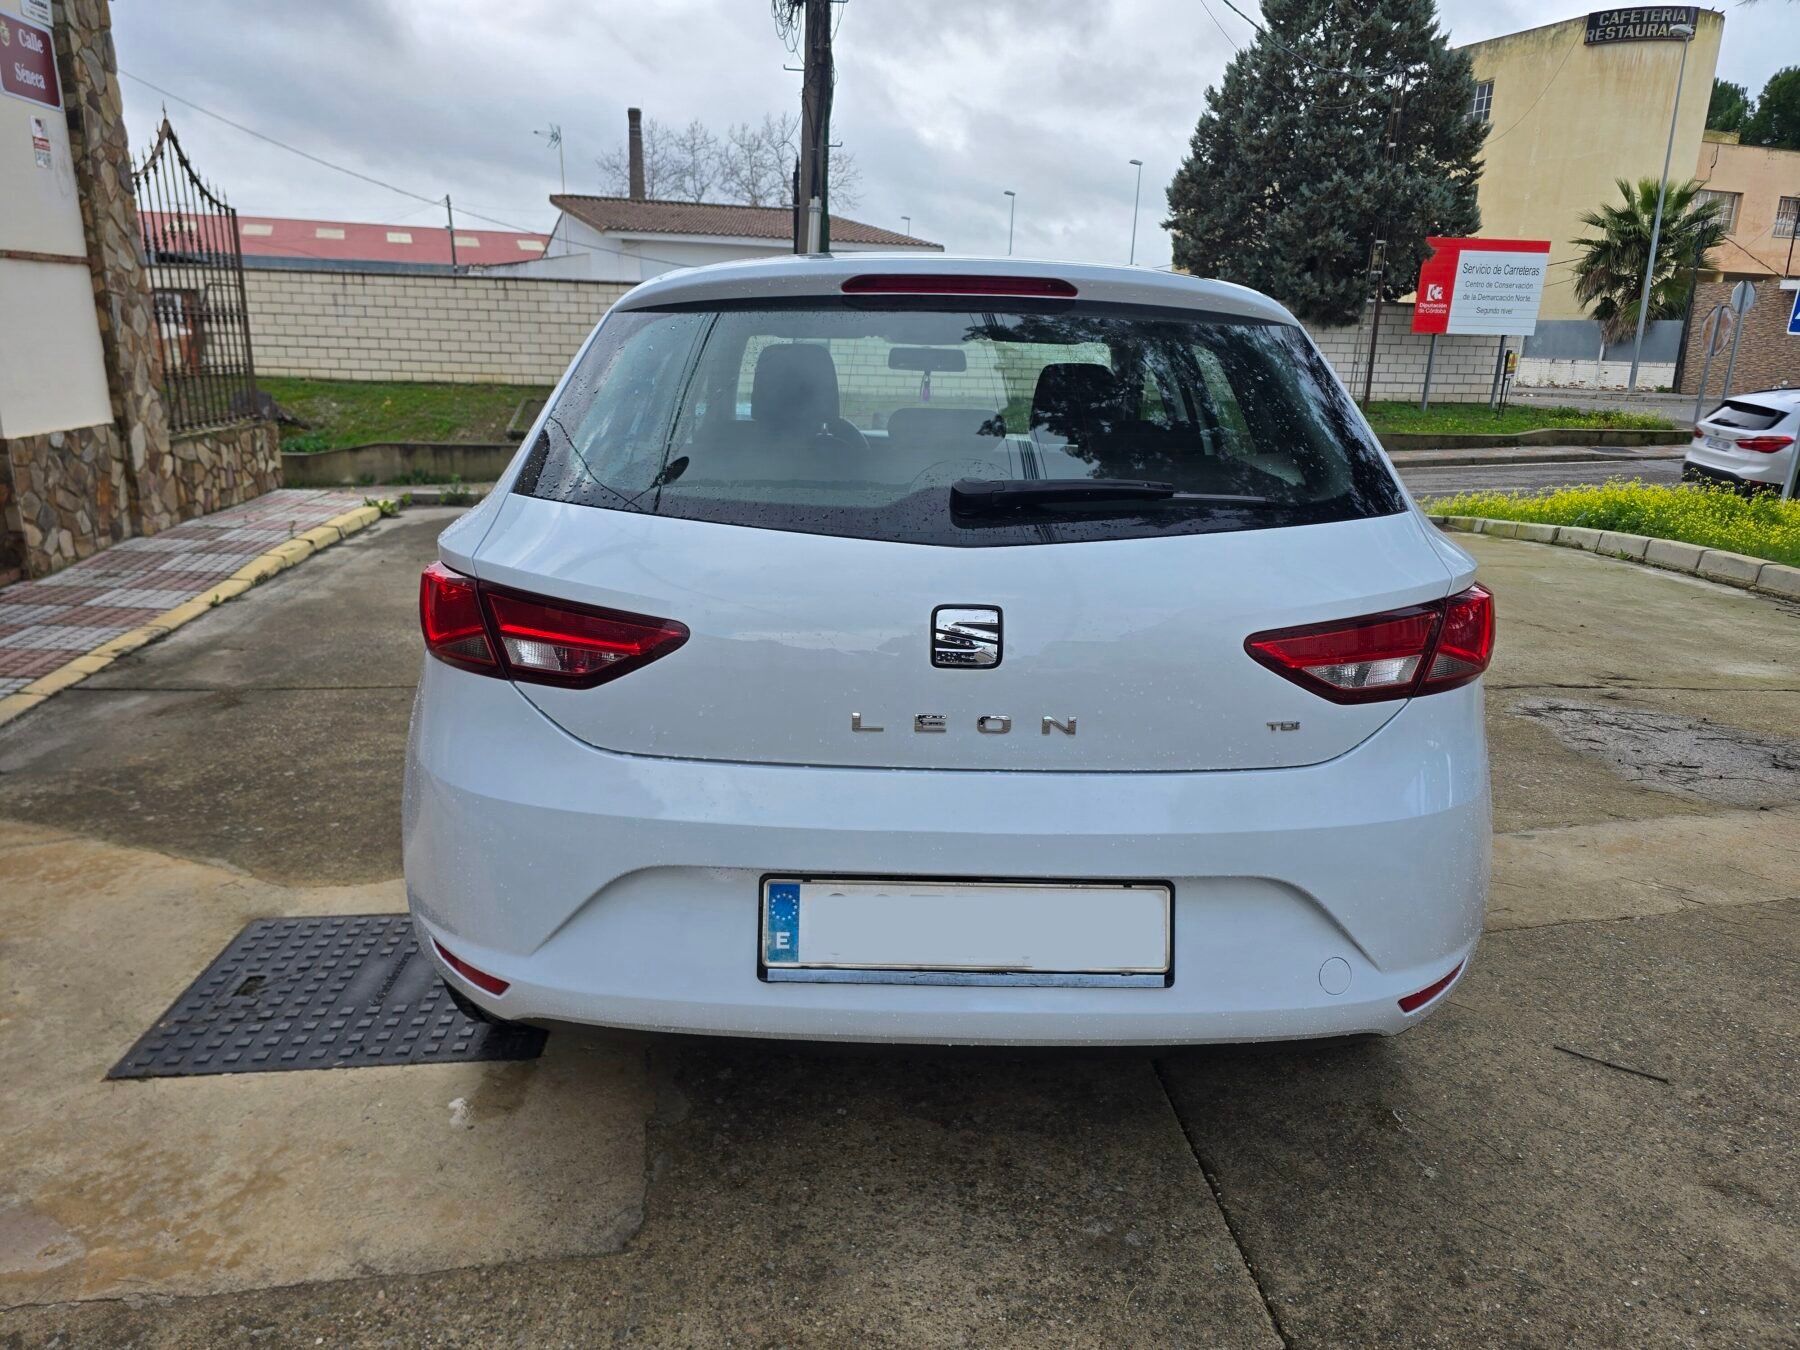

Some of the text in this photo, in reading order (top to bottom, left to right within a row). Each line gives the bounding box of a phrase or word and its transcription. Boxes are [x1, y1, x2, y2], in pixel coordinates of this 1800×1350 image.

[1599, 8, 1686, 26] CAFETERIA
[18, 28, 44, 54] Calle
[1585, 23, 1696, 42] RESTAURA
[14, 62, 46, 90] Séneca
[1462, 262, 1540, 276] Servicio de Carreteras
[1465, 280, 1484, 288] Centro
[1494, 281, 1533, 290] Conservación
[1477, 293, 1514, 302] Demarcación
[1514, 294, 1531, 302] Norte
[1476, 306, 1513, 315] Segundo nivel
[852, 712, 1077, 735] LEON
[776, 931, 790, 949] E
